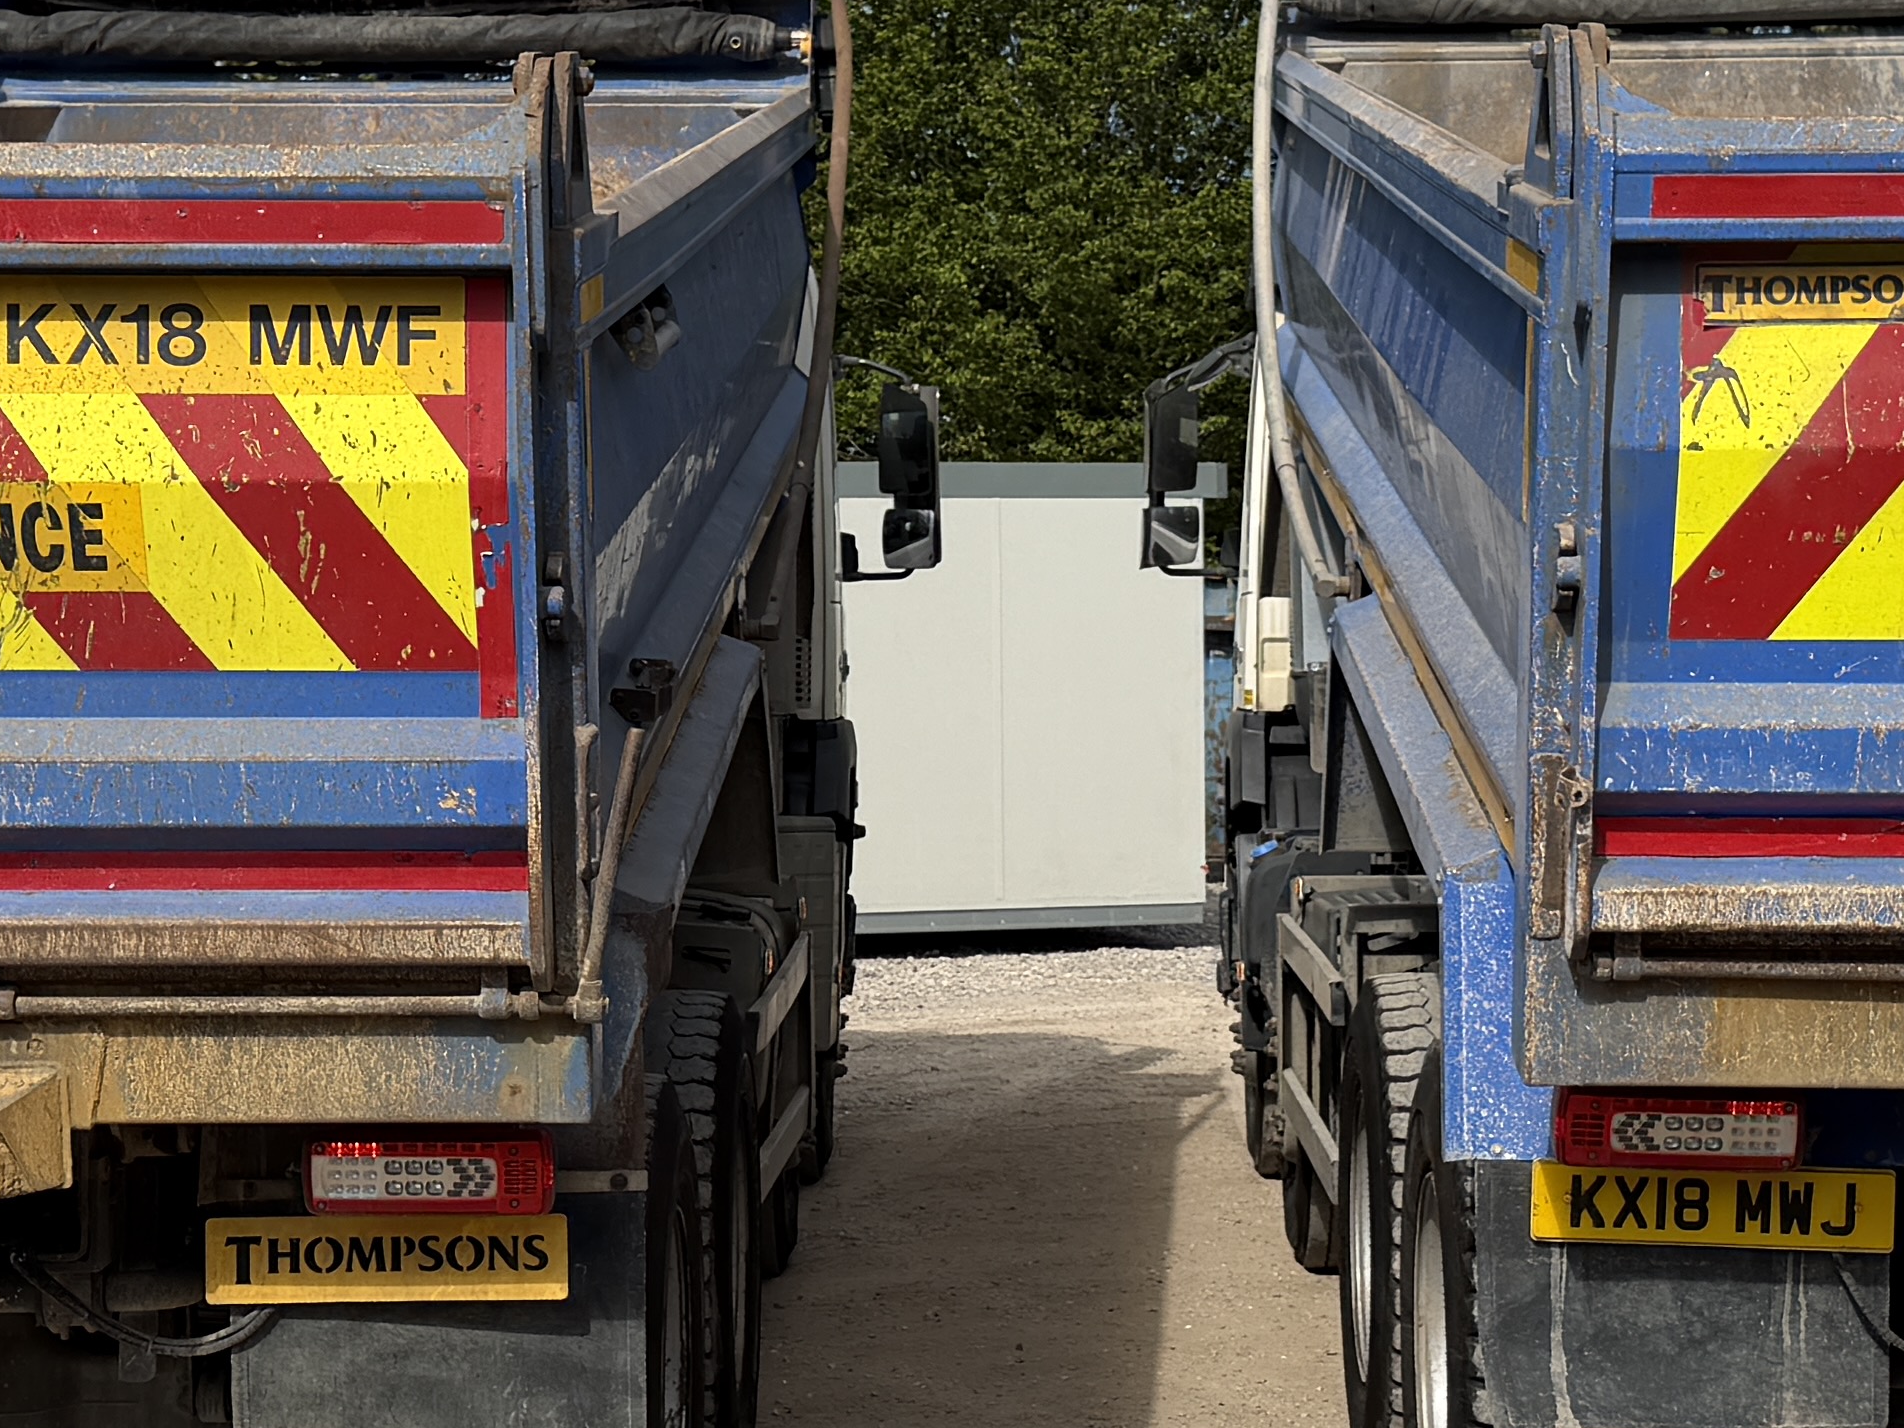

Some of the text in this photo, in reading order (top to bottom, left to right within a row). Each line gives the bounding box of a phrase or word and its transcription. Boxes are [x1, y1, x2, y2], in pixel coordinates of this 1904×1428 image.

[6, 304, 442, 366] KX18 MWF
[1568, 1174, 1858, 1237] KX18 MWJ
[224, 1234, 549, 1285] THOMPSONS
